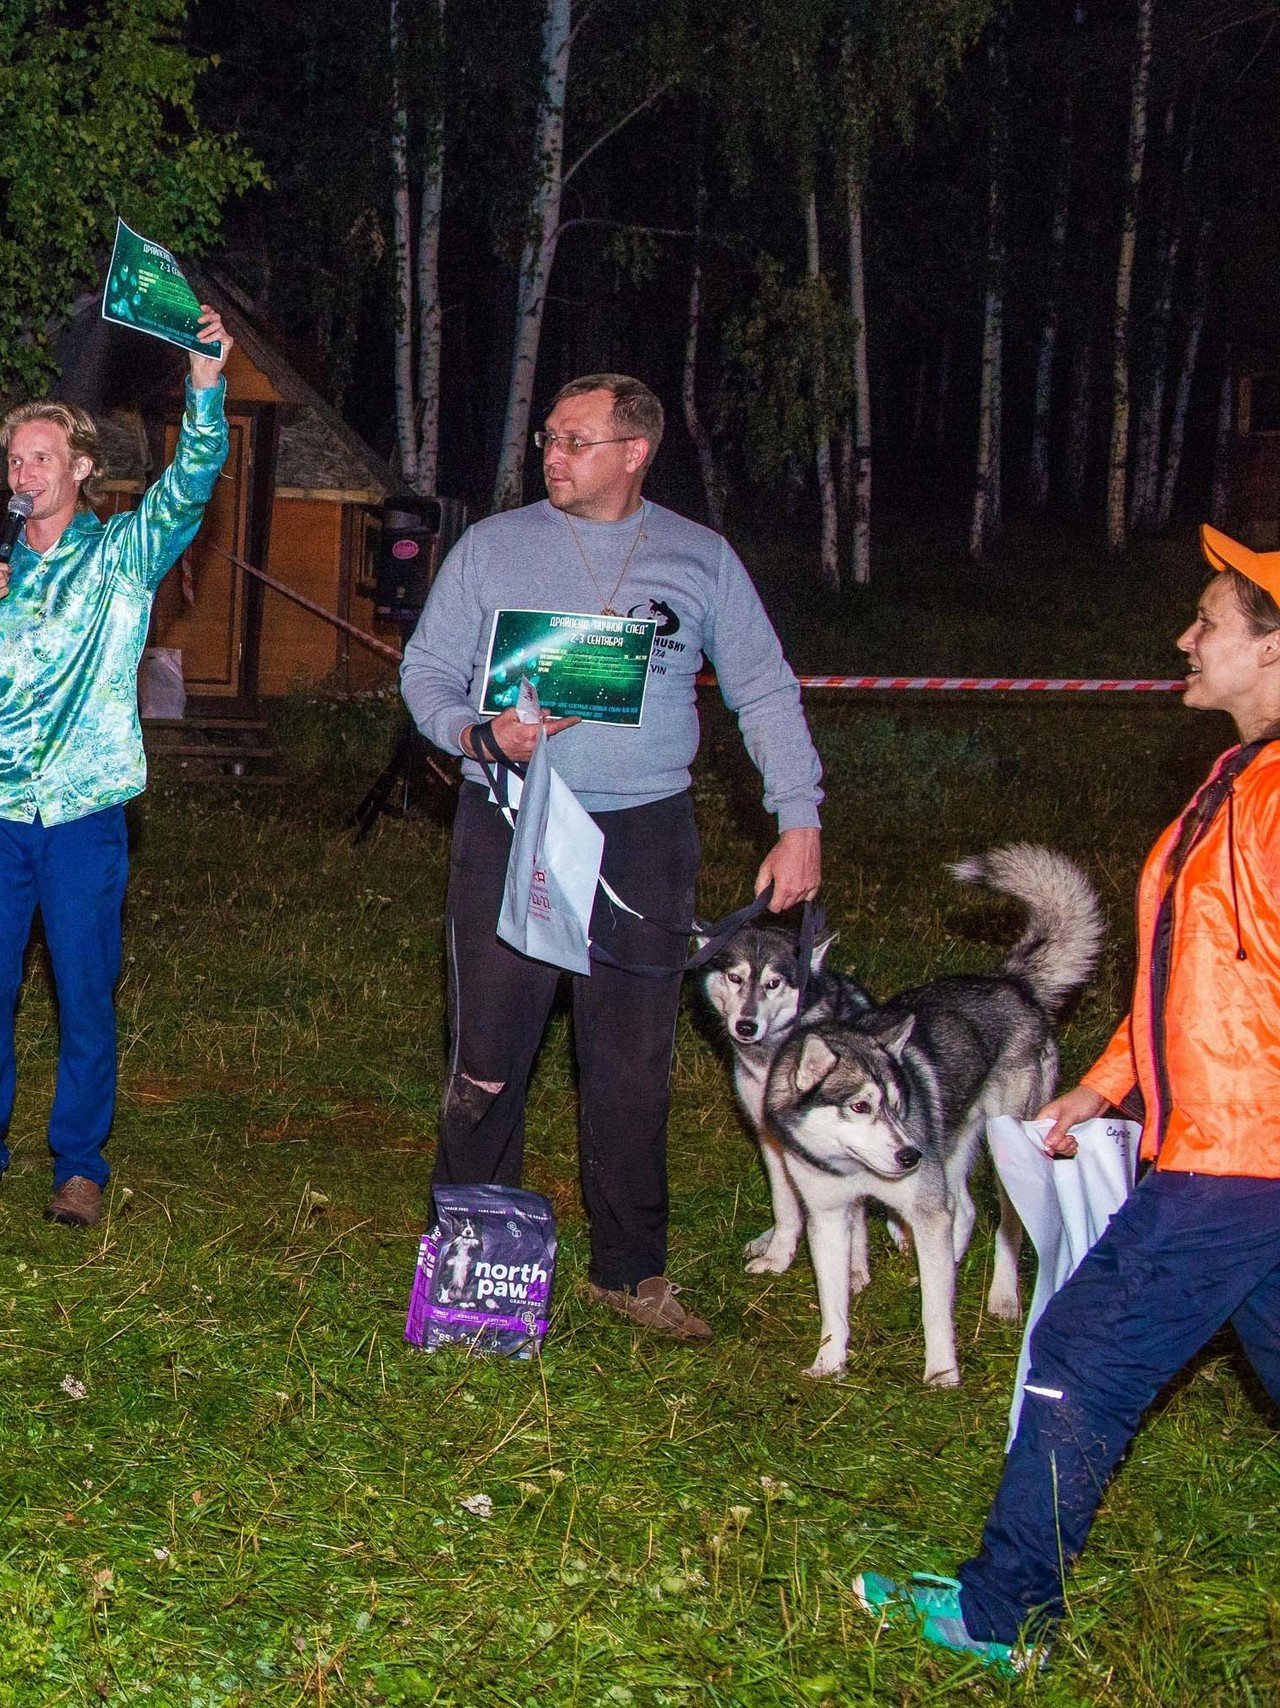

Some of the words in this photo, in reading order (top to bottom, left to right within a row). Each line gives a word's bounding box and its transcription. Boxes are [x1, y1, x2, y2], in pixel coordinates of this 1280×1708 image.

[587, 634, 624, 647] СЕНТЯБРЯ
[475, 1261, 547, 1284] north
[477, 1279, 528, 1300] paw
